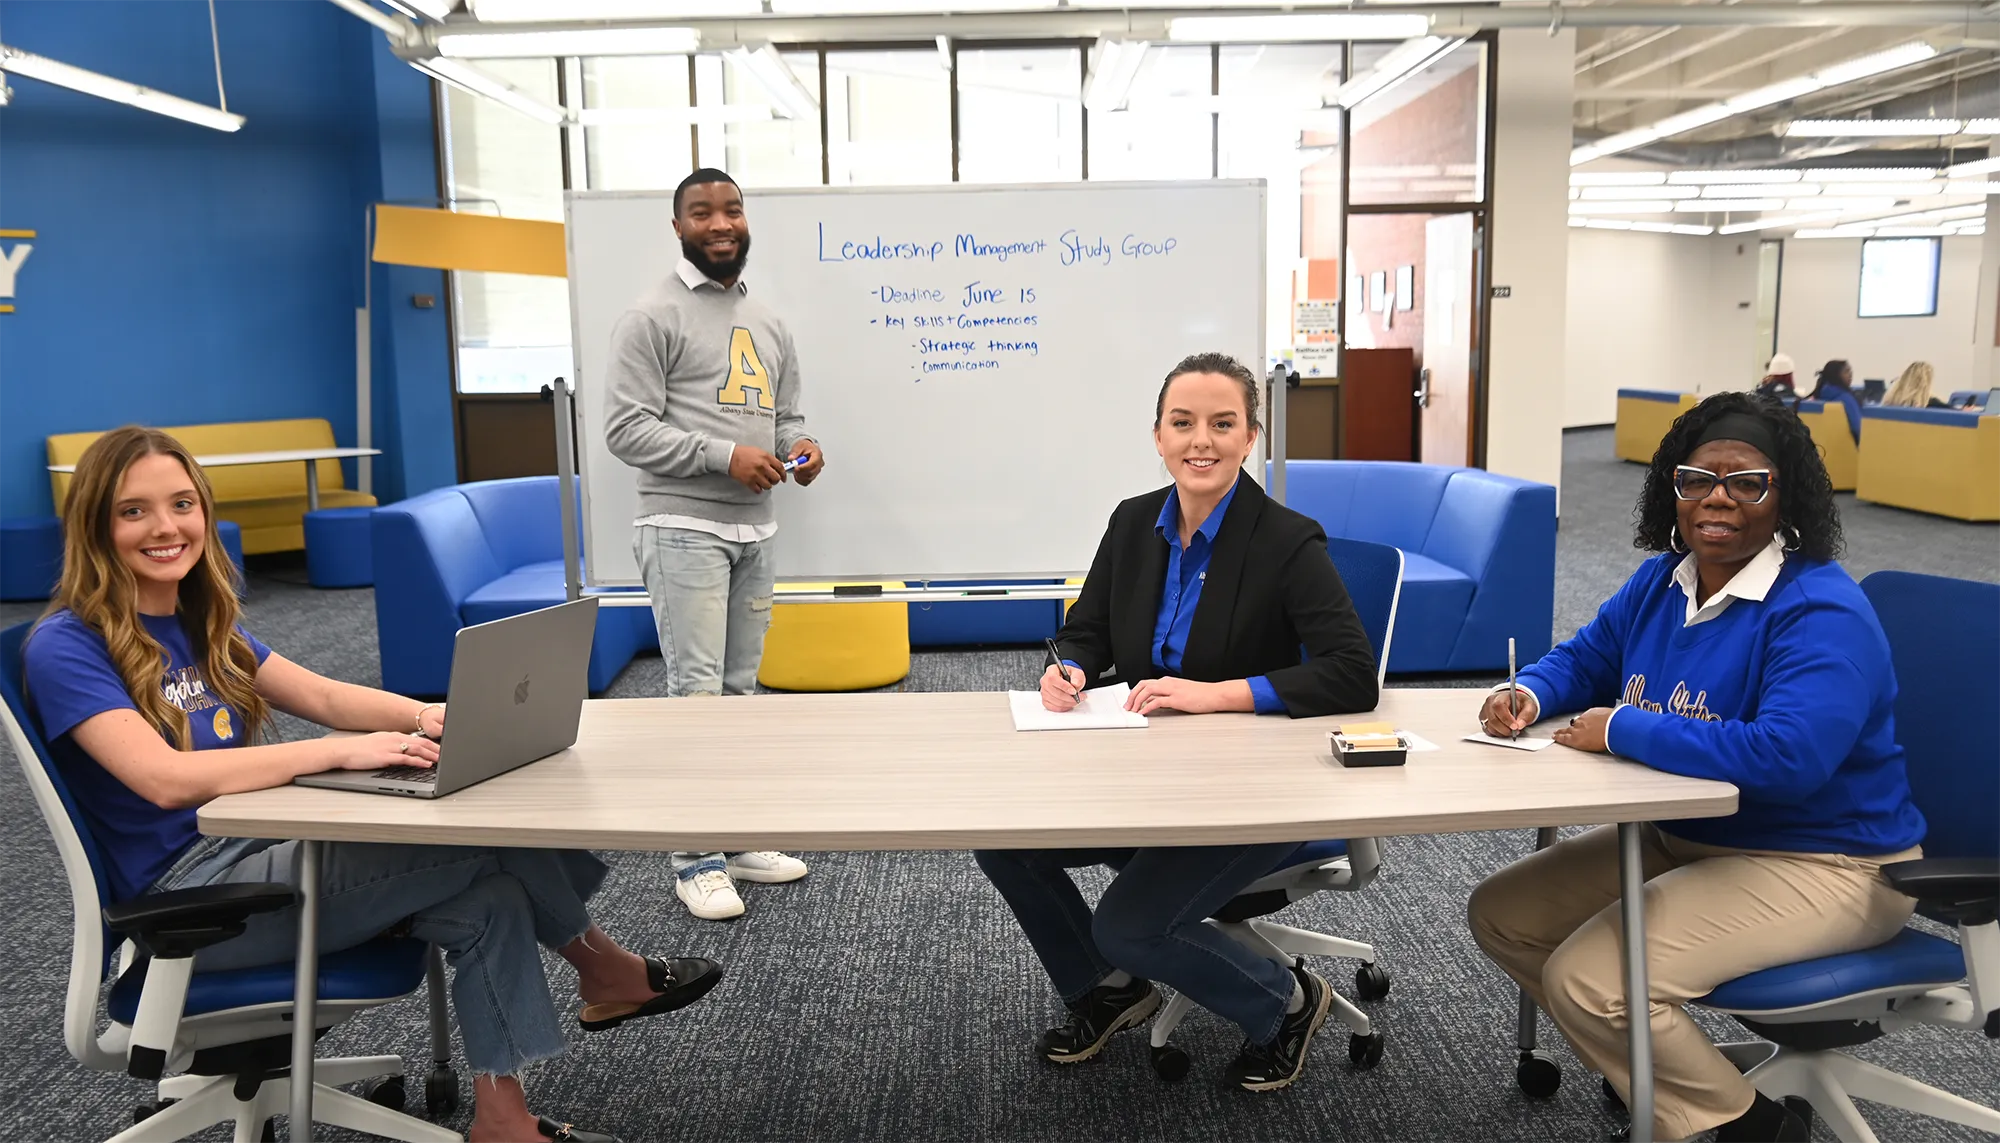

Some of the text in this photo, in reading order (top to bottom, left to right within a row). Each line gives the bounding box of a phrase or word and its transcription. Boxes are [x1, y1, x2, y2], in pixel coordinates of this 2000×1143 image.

[819, 222, 1177, 265] Leadership Management Study Group
[963, 281, 1005, 307] June
[1020, 288, 1036, 303] 15
[957, 314, 1038, 329] Competencies
[988, 340, 1039, 355] thinking
[717, 326, 774, 411] A
[923, 360, 999, 374] Communication
